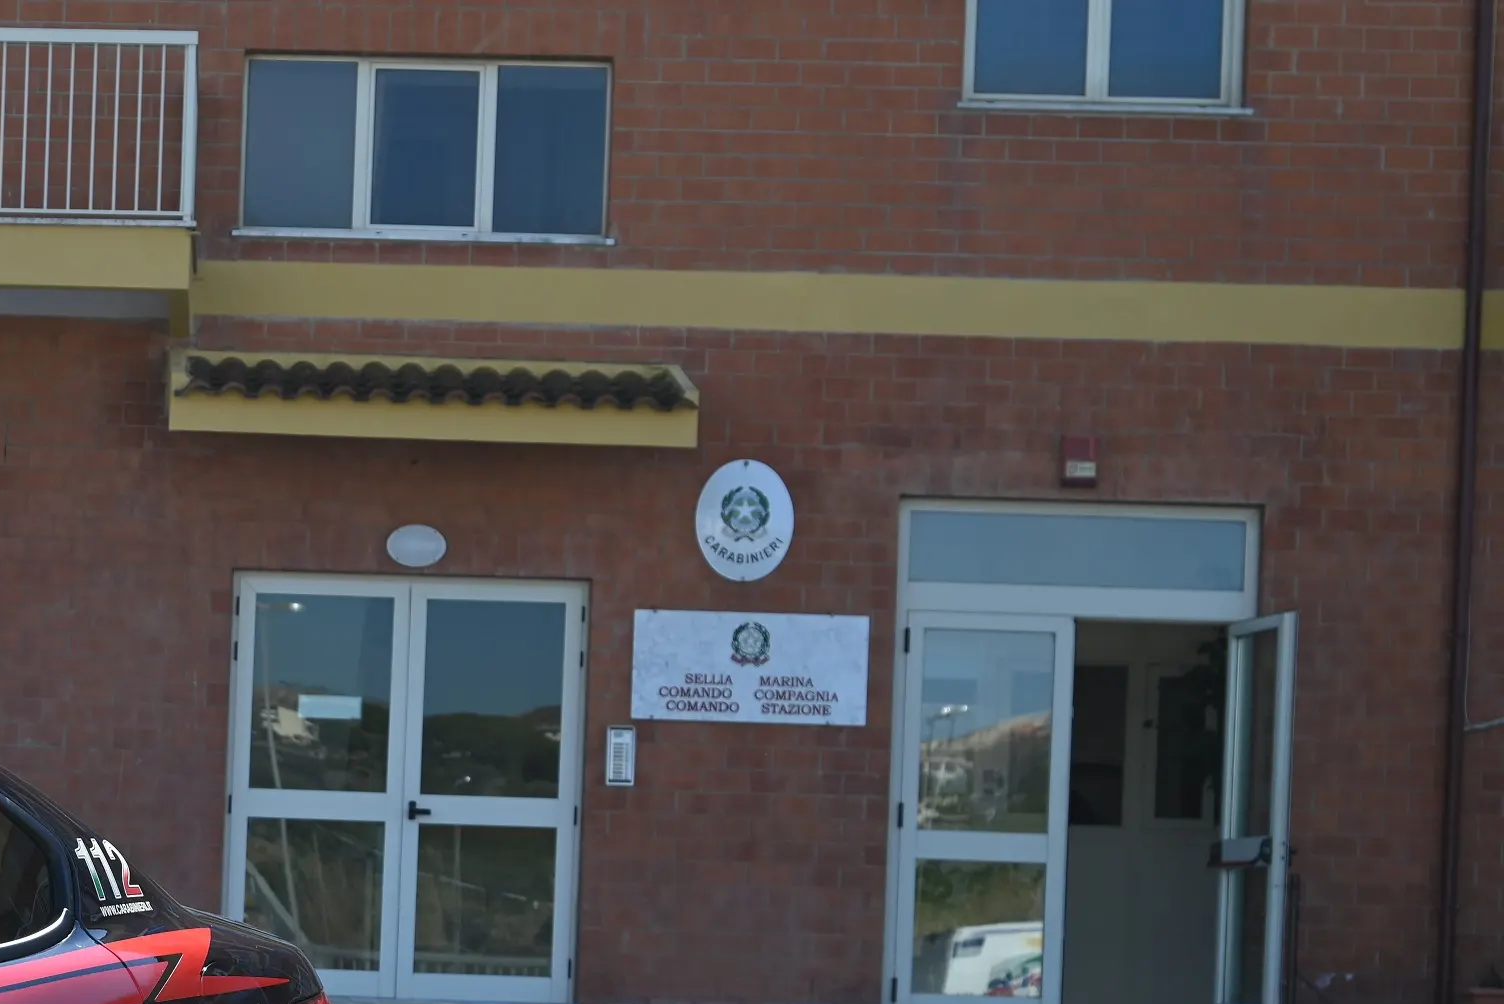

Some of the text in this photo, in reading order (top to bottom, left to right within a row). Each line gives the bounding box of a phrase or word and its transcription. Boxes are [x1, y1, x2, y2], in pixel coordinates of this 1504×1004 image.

[704, 534, 784, 564] CARABINIERI
[684, 672, 814, 688] SELLIA MARINA
[658, 686, 840, 702] COMANDO COMPAGNIA
[666, 700, 832, 717] COMANDO STAZIONE
[74, 838, 144, 901] 112
